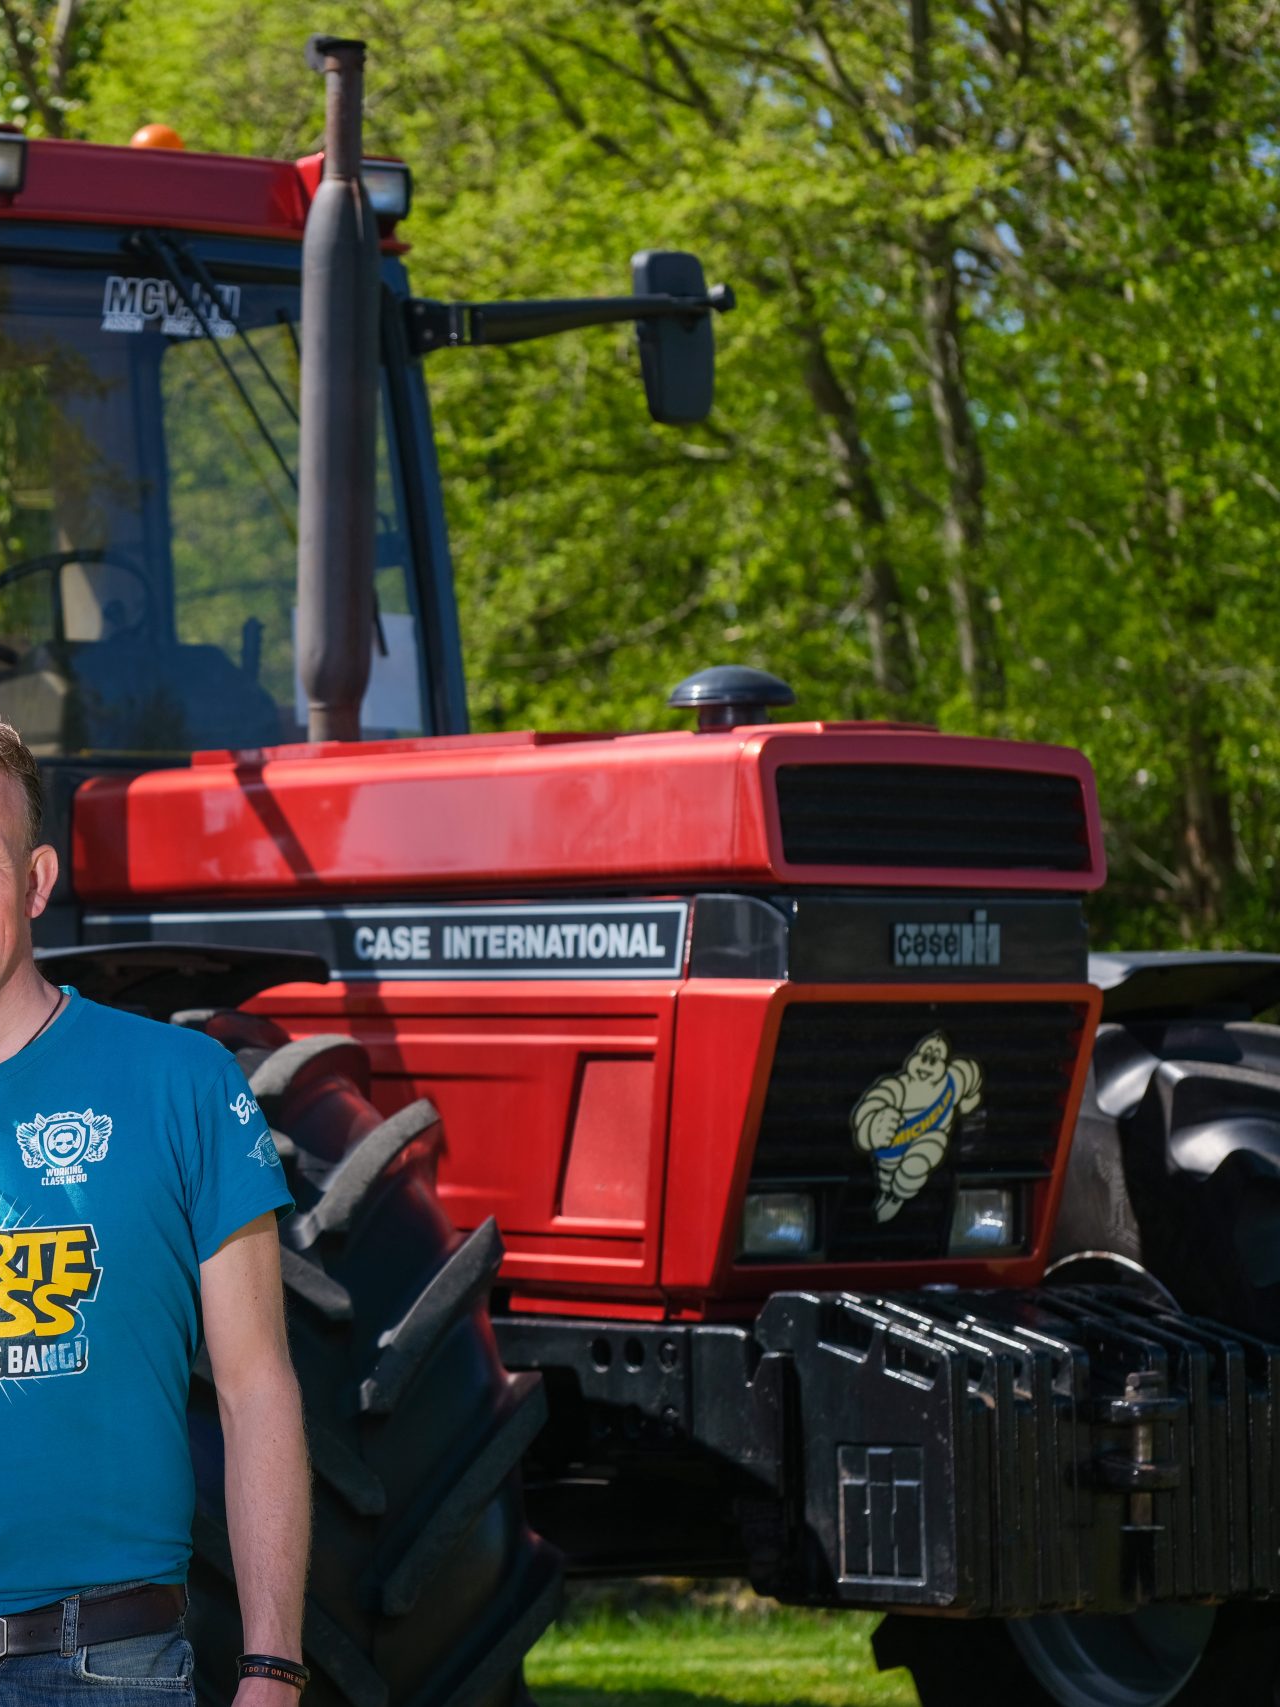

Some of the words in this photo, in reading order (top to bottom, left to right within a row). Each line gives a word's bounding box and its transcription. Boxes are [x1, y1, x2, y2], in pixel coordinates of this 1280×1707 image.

[354, 926, 431, 961] CASE
[442, 922, 666, 960] INTERNATIONAL
[46, 1165, 83, 1176] WORKING
[41, 1177, 65, 1186] CLASS
[66, 1173, 87, 1184] HERO
[7, 1340, 83, 1374] BANG!
[248, 1665, 259, 1673] DO
[261, 1666, 269, 1674] IT
[271, 1668, 282, 1677] ON
[283, 1671, 294, 1681] THE
